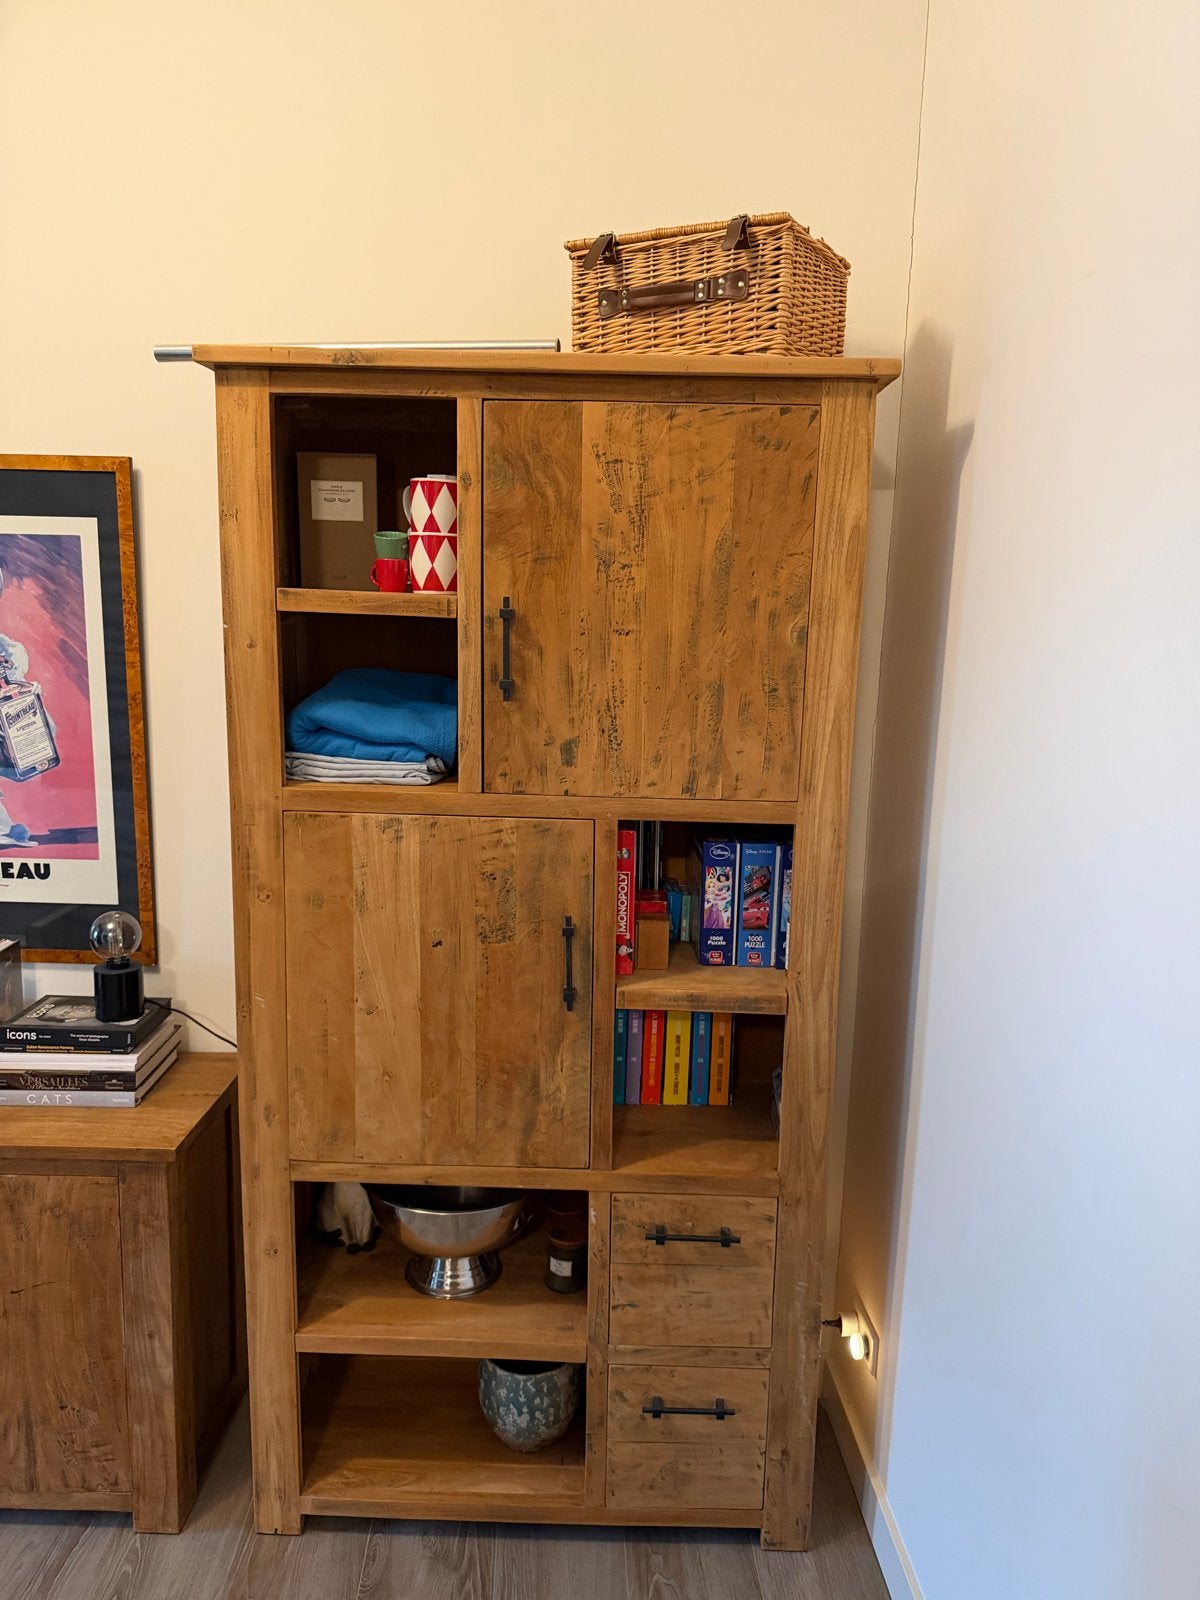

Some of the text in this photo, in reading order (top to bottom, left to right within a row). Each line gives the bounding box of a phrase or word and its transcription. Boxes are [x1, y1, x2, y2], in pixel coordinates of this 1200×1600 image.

[1, 862, 51, 880] EAU
[618, 873, 629, 932] MONOPOLY
[6, 1029, 37, 1040] icons
[18, 1077, 88, 1086] VERSAILLES
[26, 1093, 73, 1104] CATS
